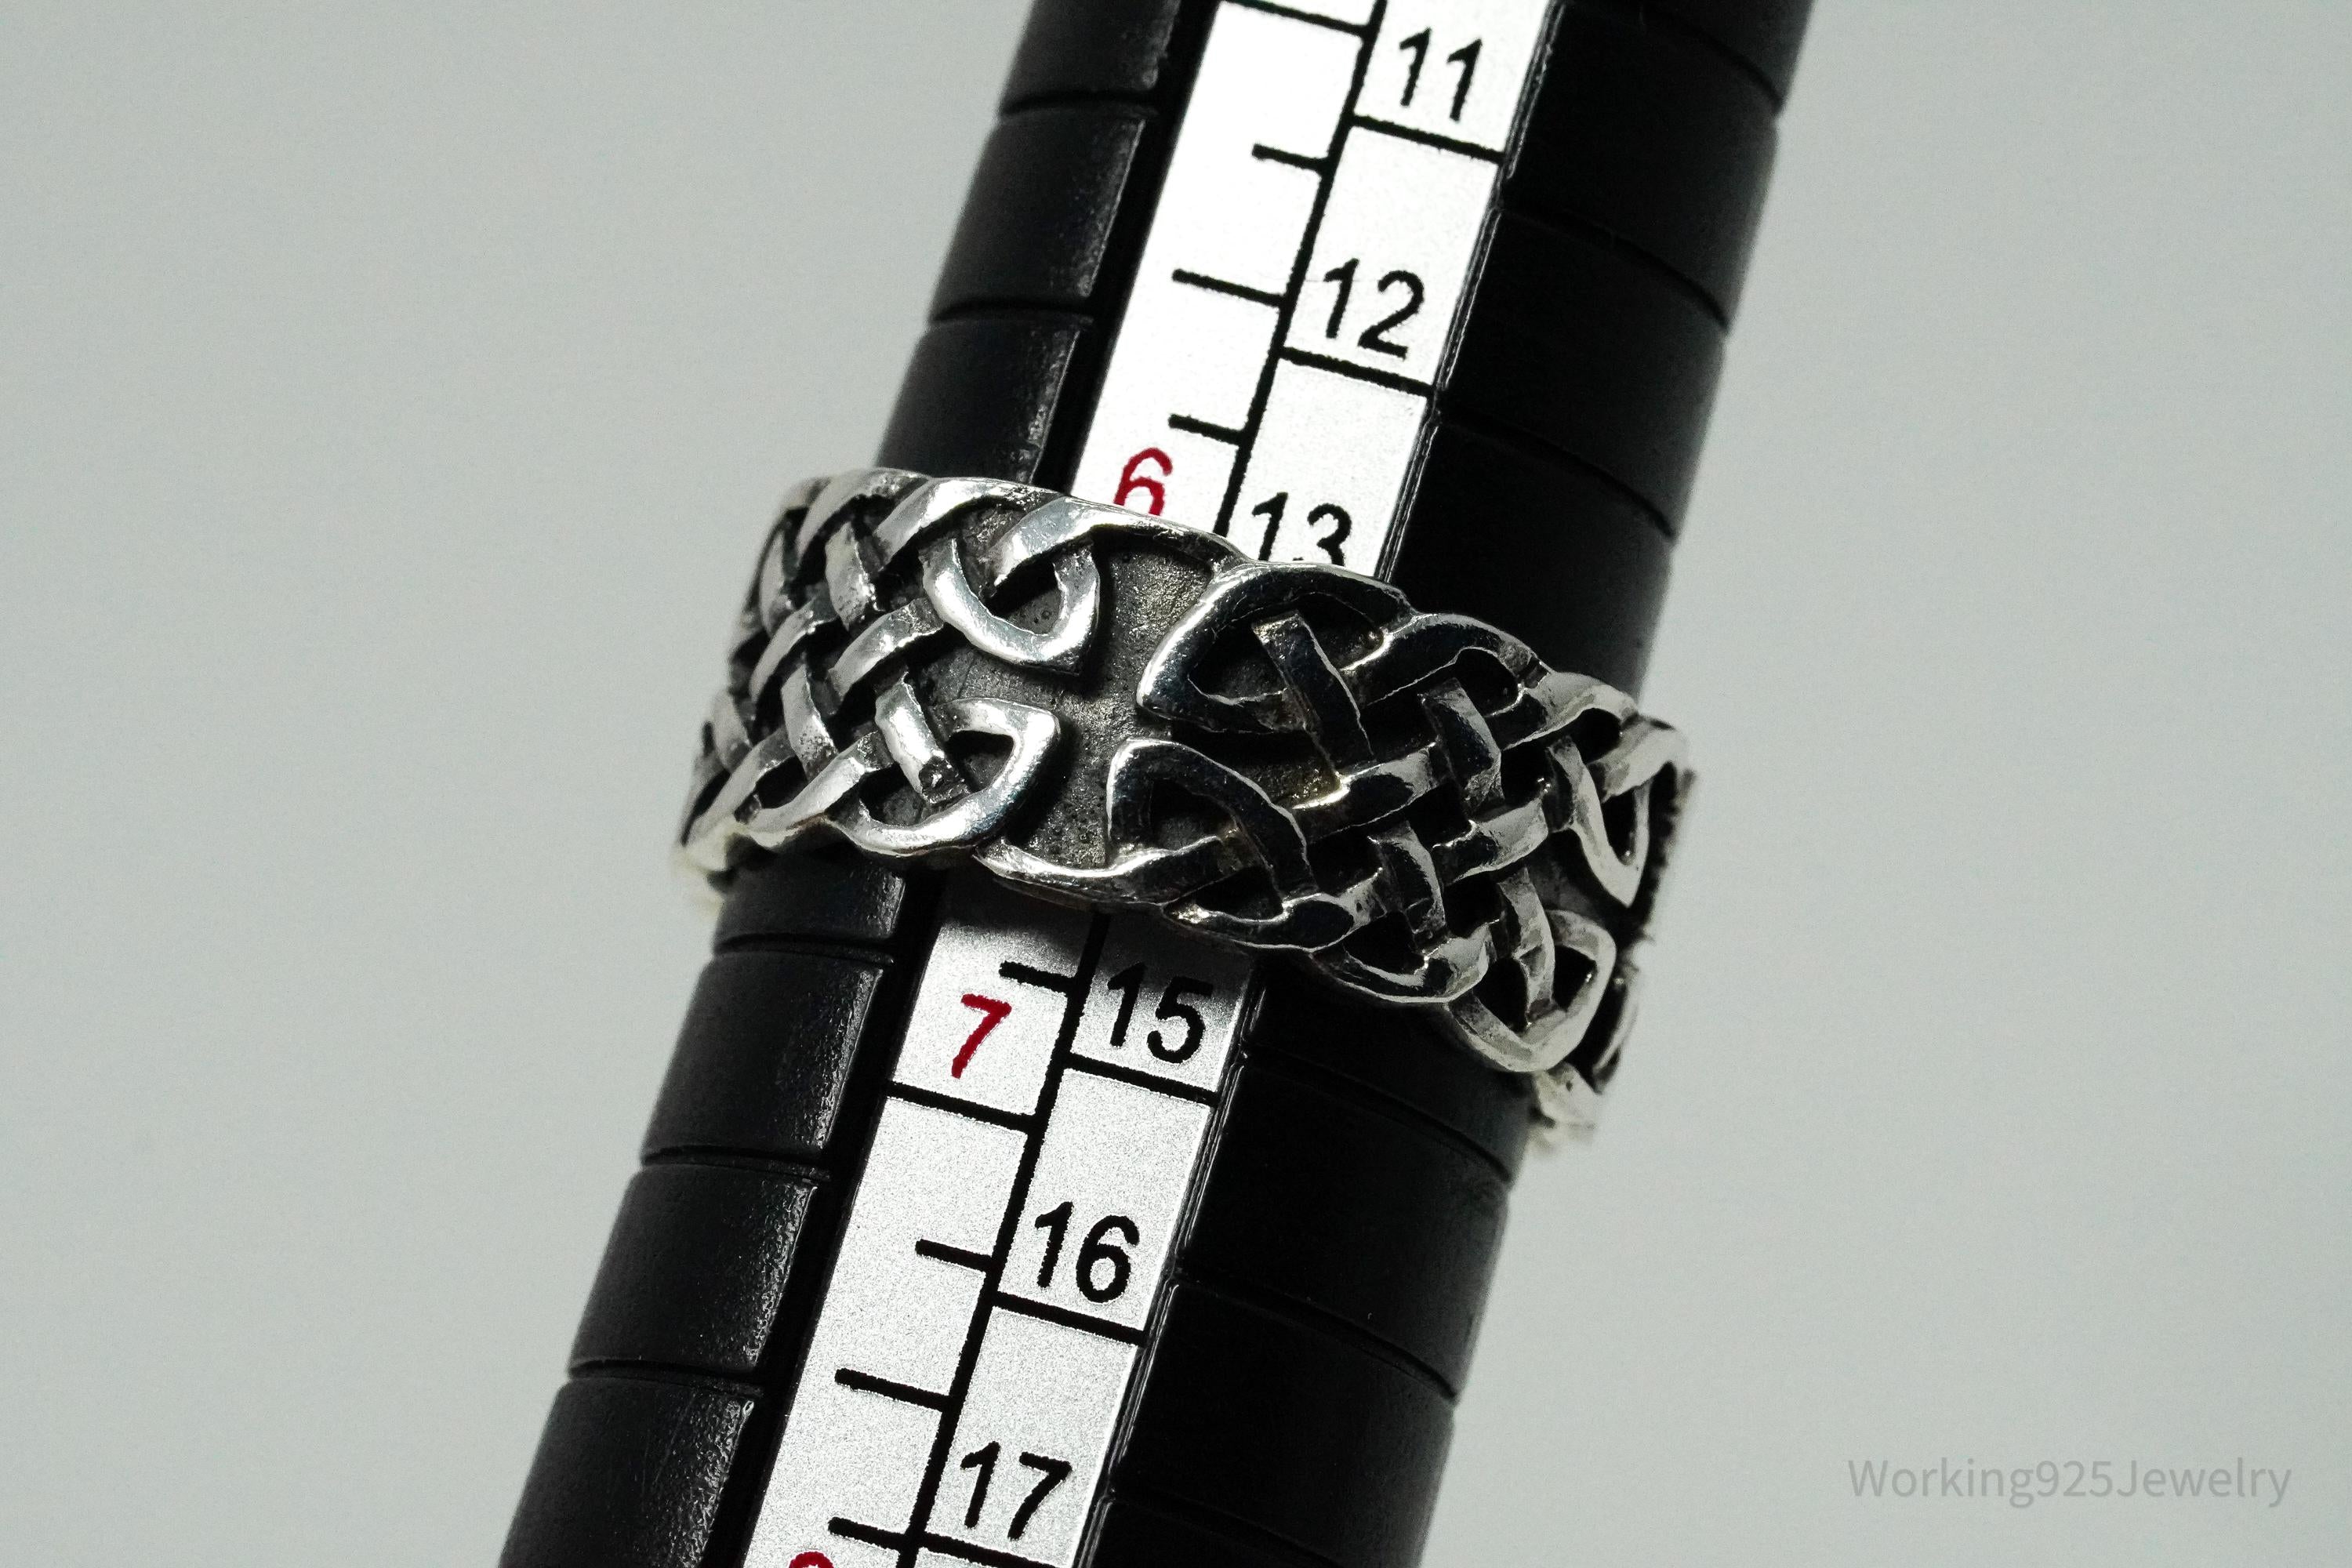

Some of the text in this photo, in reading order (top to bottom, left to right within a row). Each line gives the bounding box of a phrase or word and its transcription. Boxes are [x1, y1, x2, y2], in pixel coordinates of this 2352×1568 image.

[1399, 27, 1483, 122] 11
[1323, 258, 1425, 360] 12
[1113, 446, 1173, 517] 6
[951, 993, 1012, 1079] 7
[1107, 961, 1214, 1064] 15
[1034, 1200, 1141, 1304] 16
[960, 1441, 1073, 1541] 17
